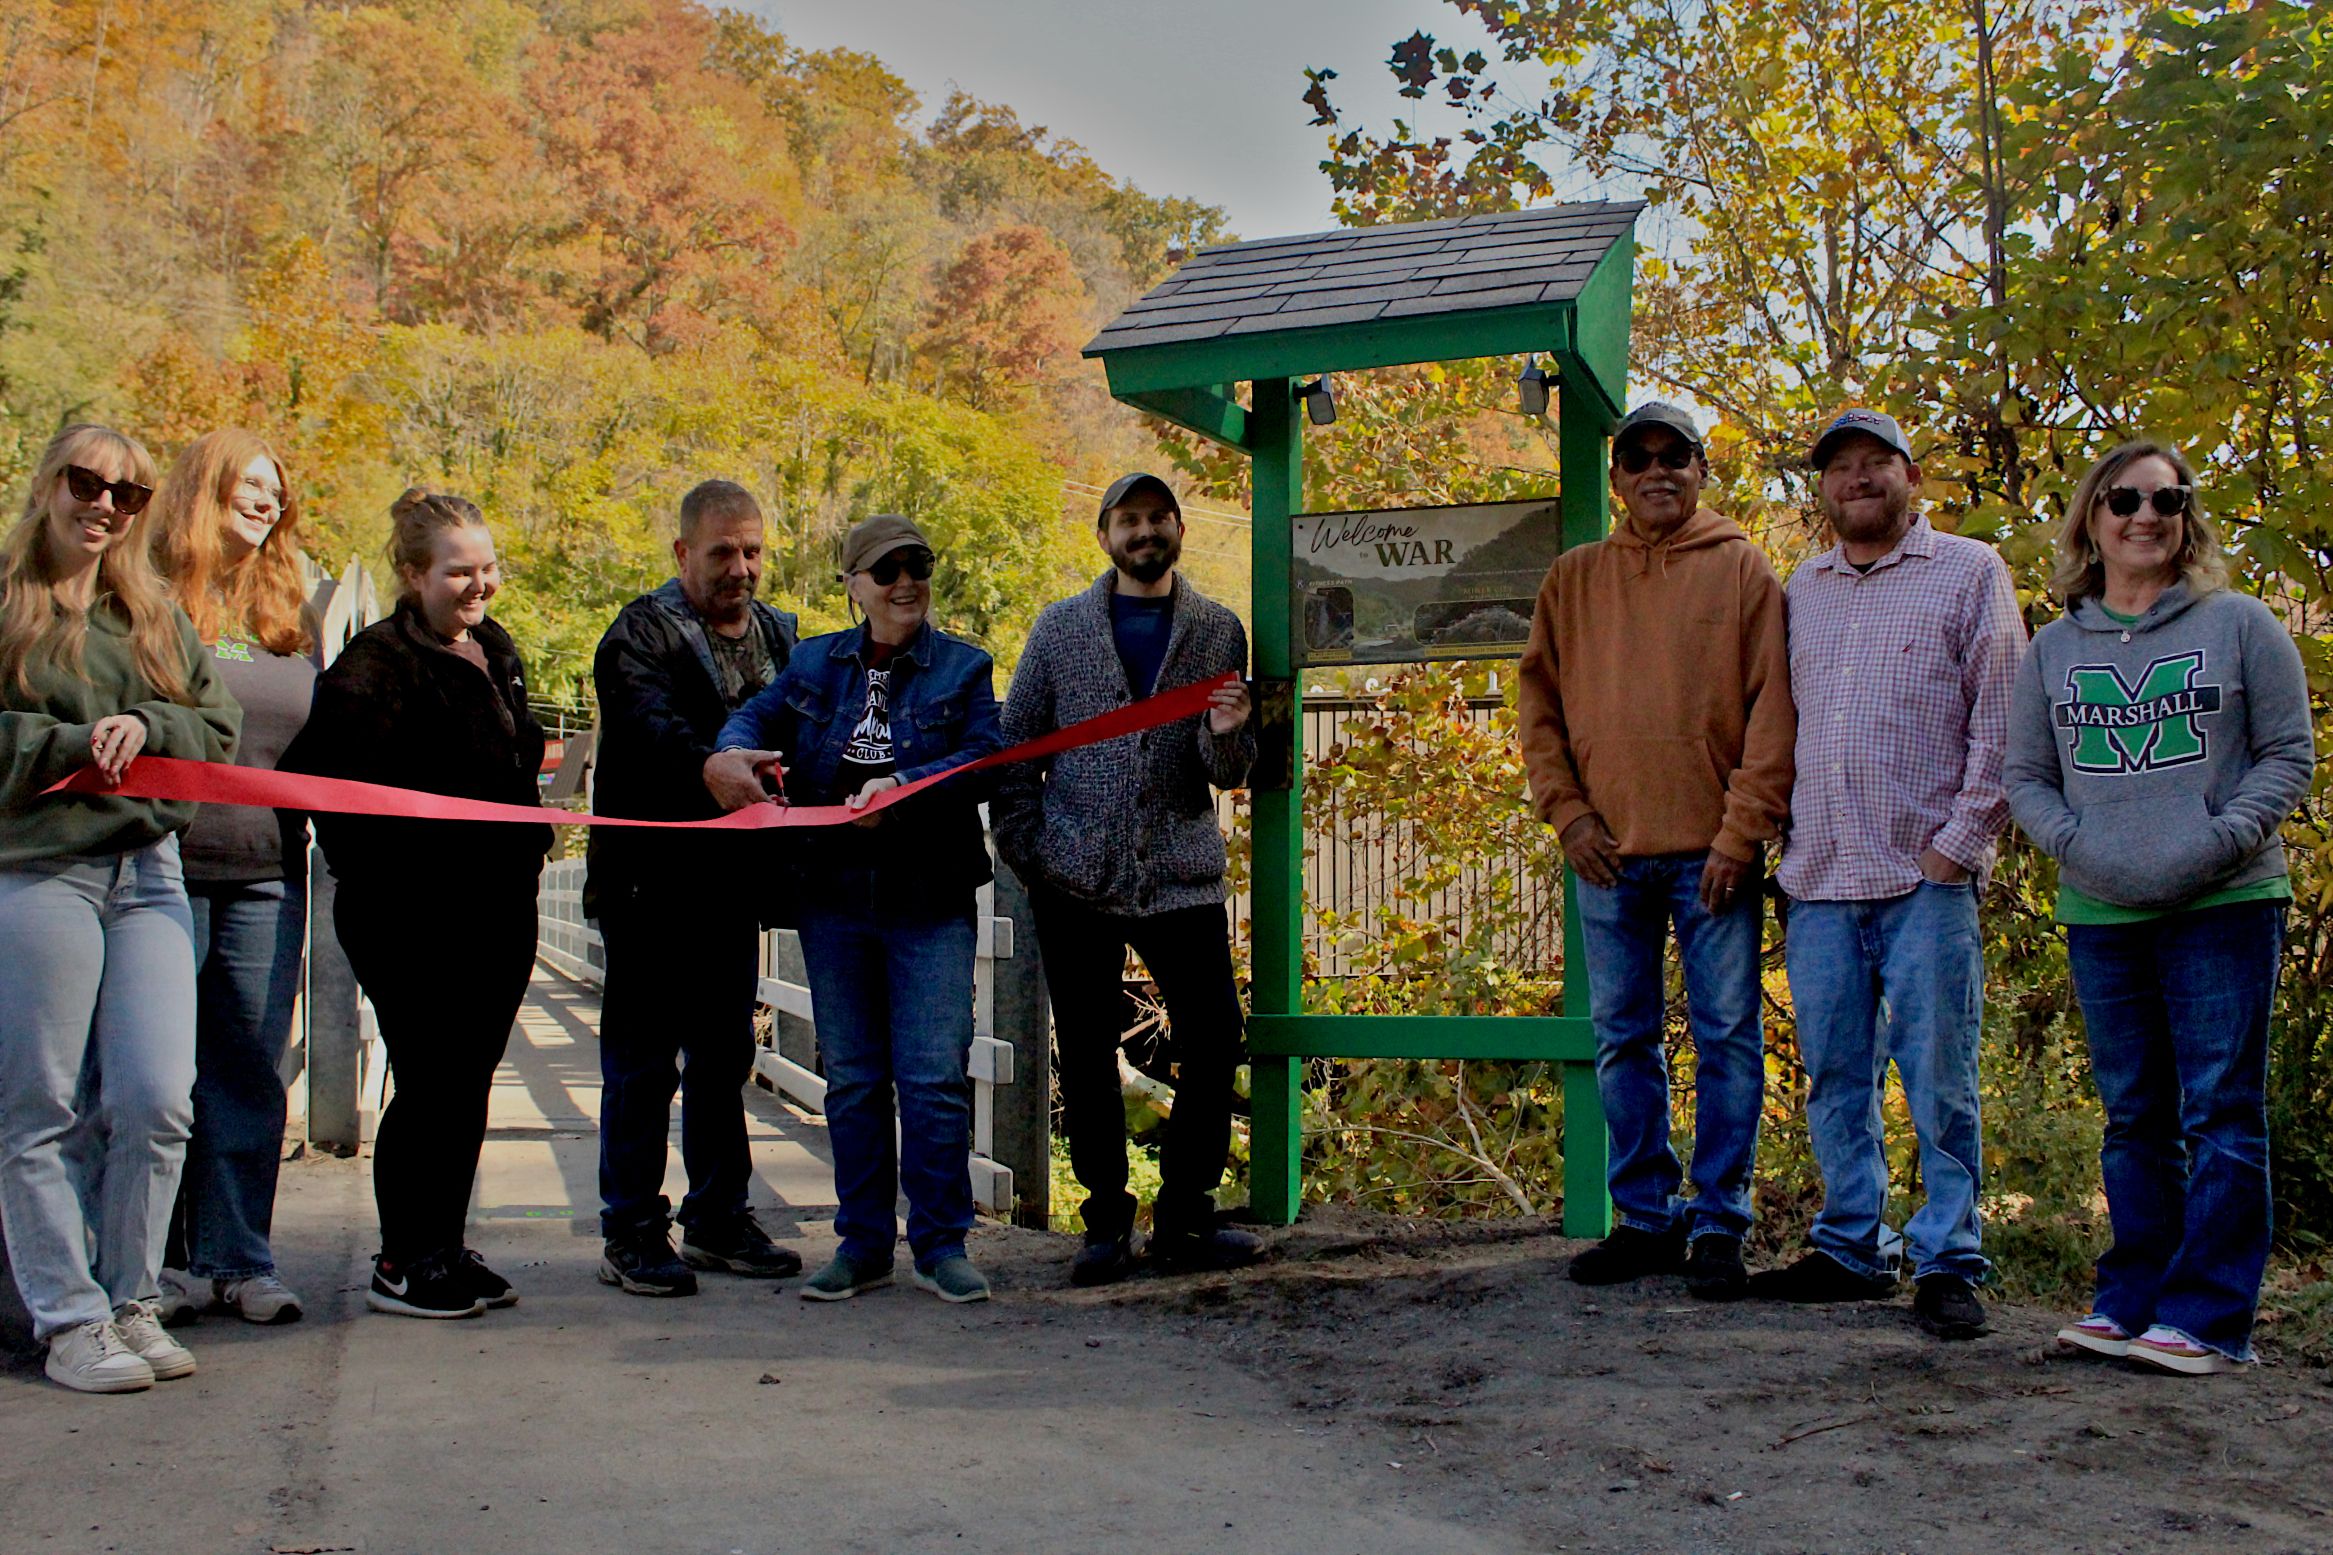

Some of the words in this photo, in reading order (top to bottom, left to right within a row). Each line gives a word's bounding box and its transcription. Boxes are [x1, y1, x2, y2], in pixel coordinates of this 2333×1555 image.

[1311, 515, 1419, 553] Welcome
[1359, 551, 1369, 559] to
[1375, 539, 1457, 568] WAR
[2064, 648, 2209, 776] M
[2067, 691, 2203, 726] MARSHALL
[856, 748, 886, 759] CLUB
